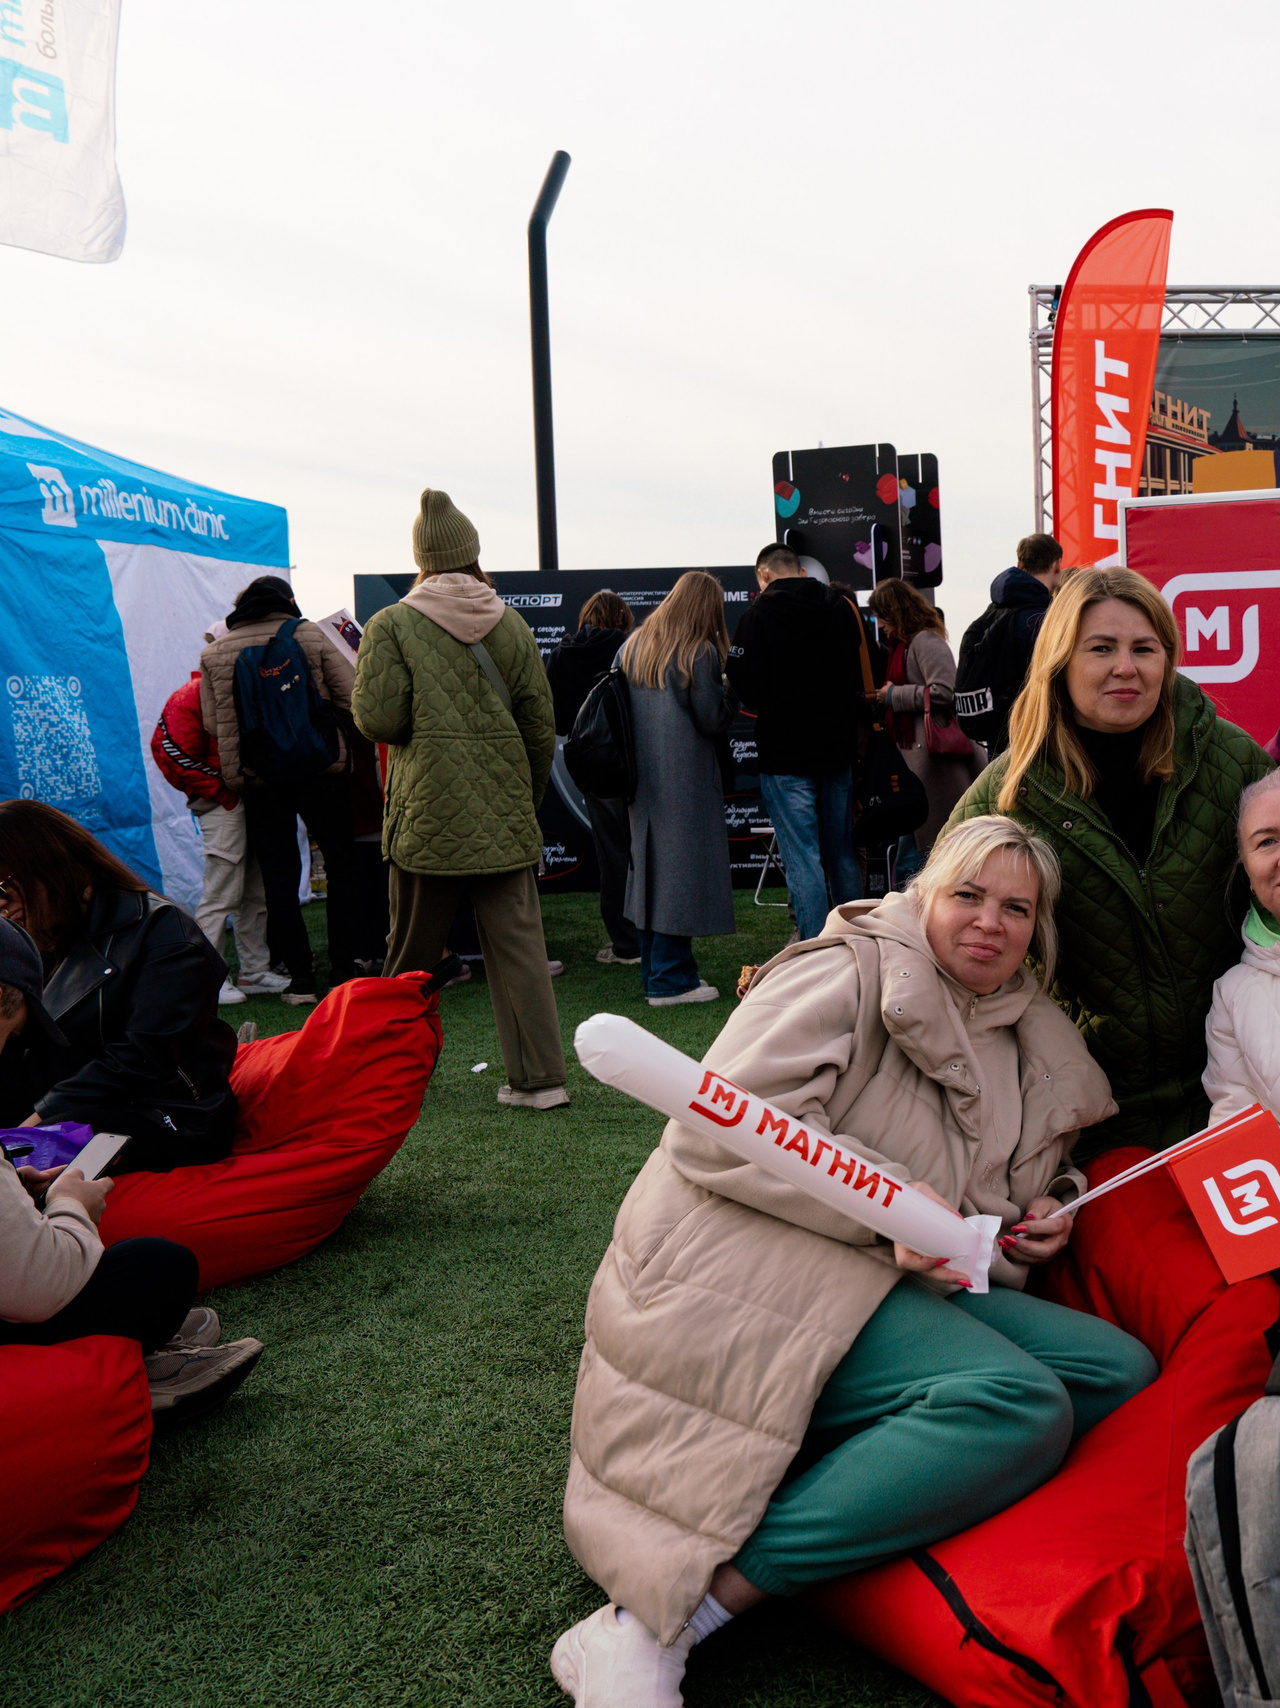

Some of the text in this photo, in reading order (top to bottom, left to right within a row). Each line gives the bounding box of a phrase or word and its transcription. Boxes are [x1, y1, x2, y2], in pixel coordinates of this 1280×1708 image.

[36, 0, 57, 59] боль
[1150, 389, 1211, 443] ГНИТ
[79, 478, 186, 531] millenium
[755, 1107, 903, 1209] МАГНИТ
